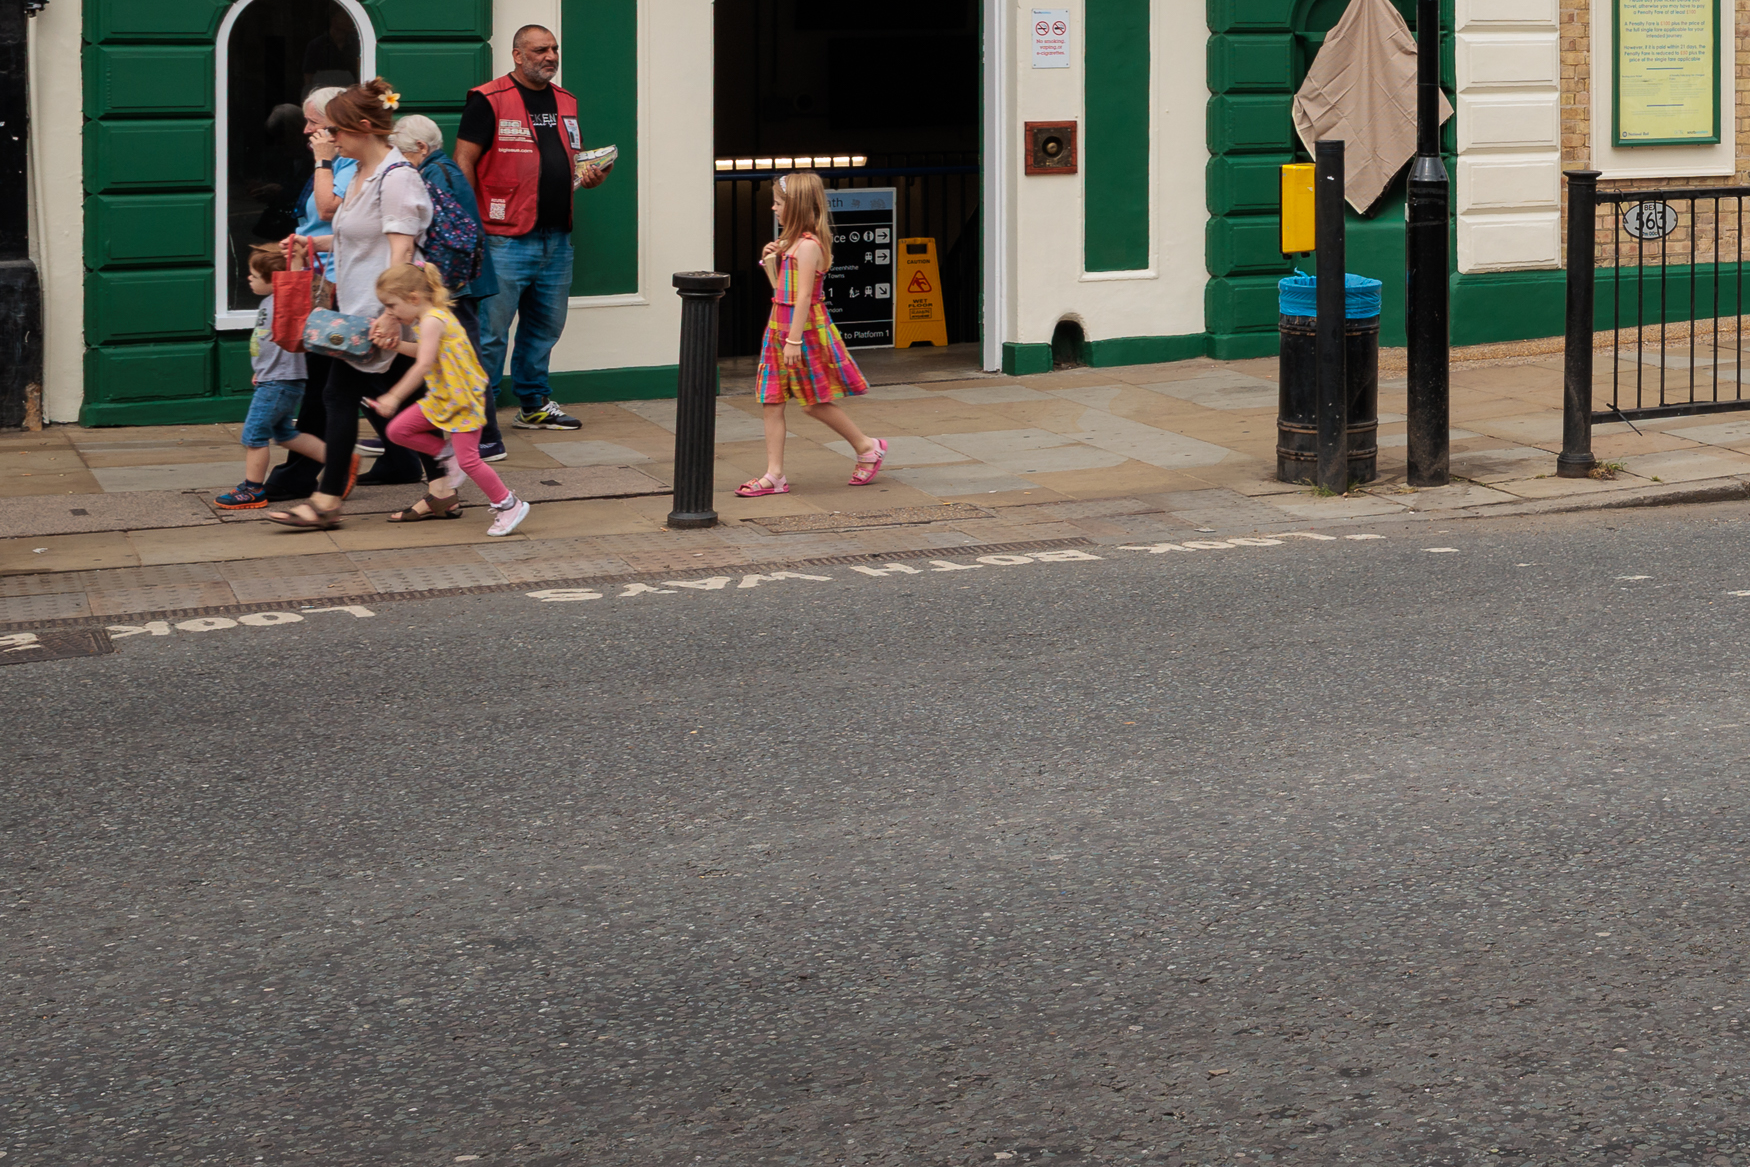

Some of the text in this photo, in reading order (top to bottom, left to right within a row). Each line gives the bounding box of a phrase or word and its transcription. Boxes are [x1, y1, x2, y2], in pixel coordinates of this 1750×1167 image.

[828, 288, 834, 297] 1
[854, 330, 884, 339] Platform
[850, 549, 1104, 577] BOTH
[525, 570, 834, 603] WAYS
[105, 605, 376, 640] LOOK
